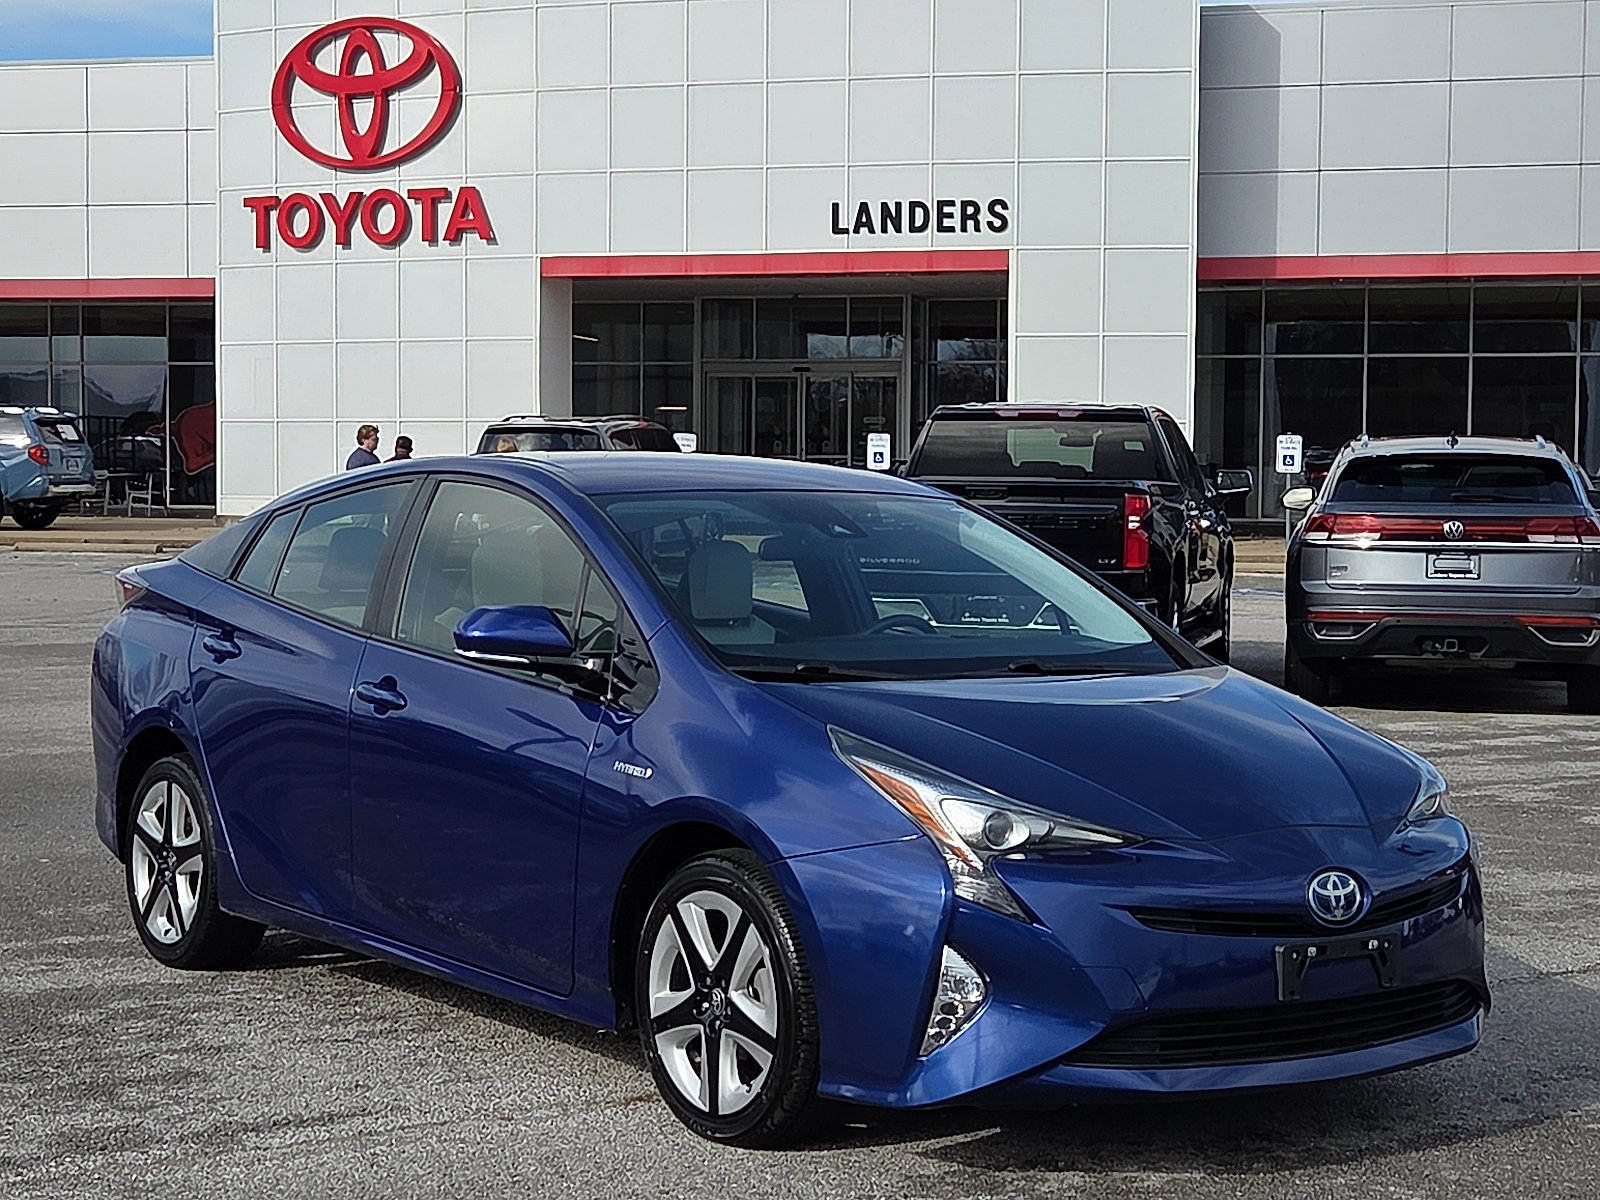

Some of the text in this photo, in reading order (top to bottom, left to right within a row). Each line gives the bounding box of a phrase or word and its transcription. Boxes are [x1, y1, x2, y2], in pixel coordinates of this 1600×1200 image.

[243, 186, 495, 251] TOYOTA
[831, 198, 1010, 235] LANDERS
[612, 760, 646, 778] HYBRID
